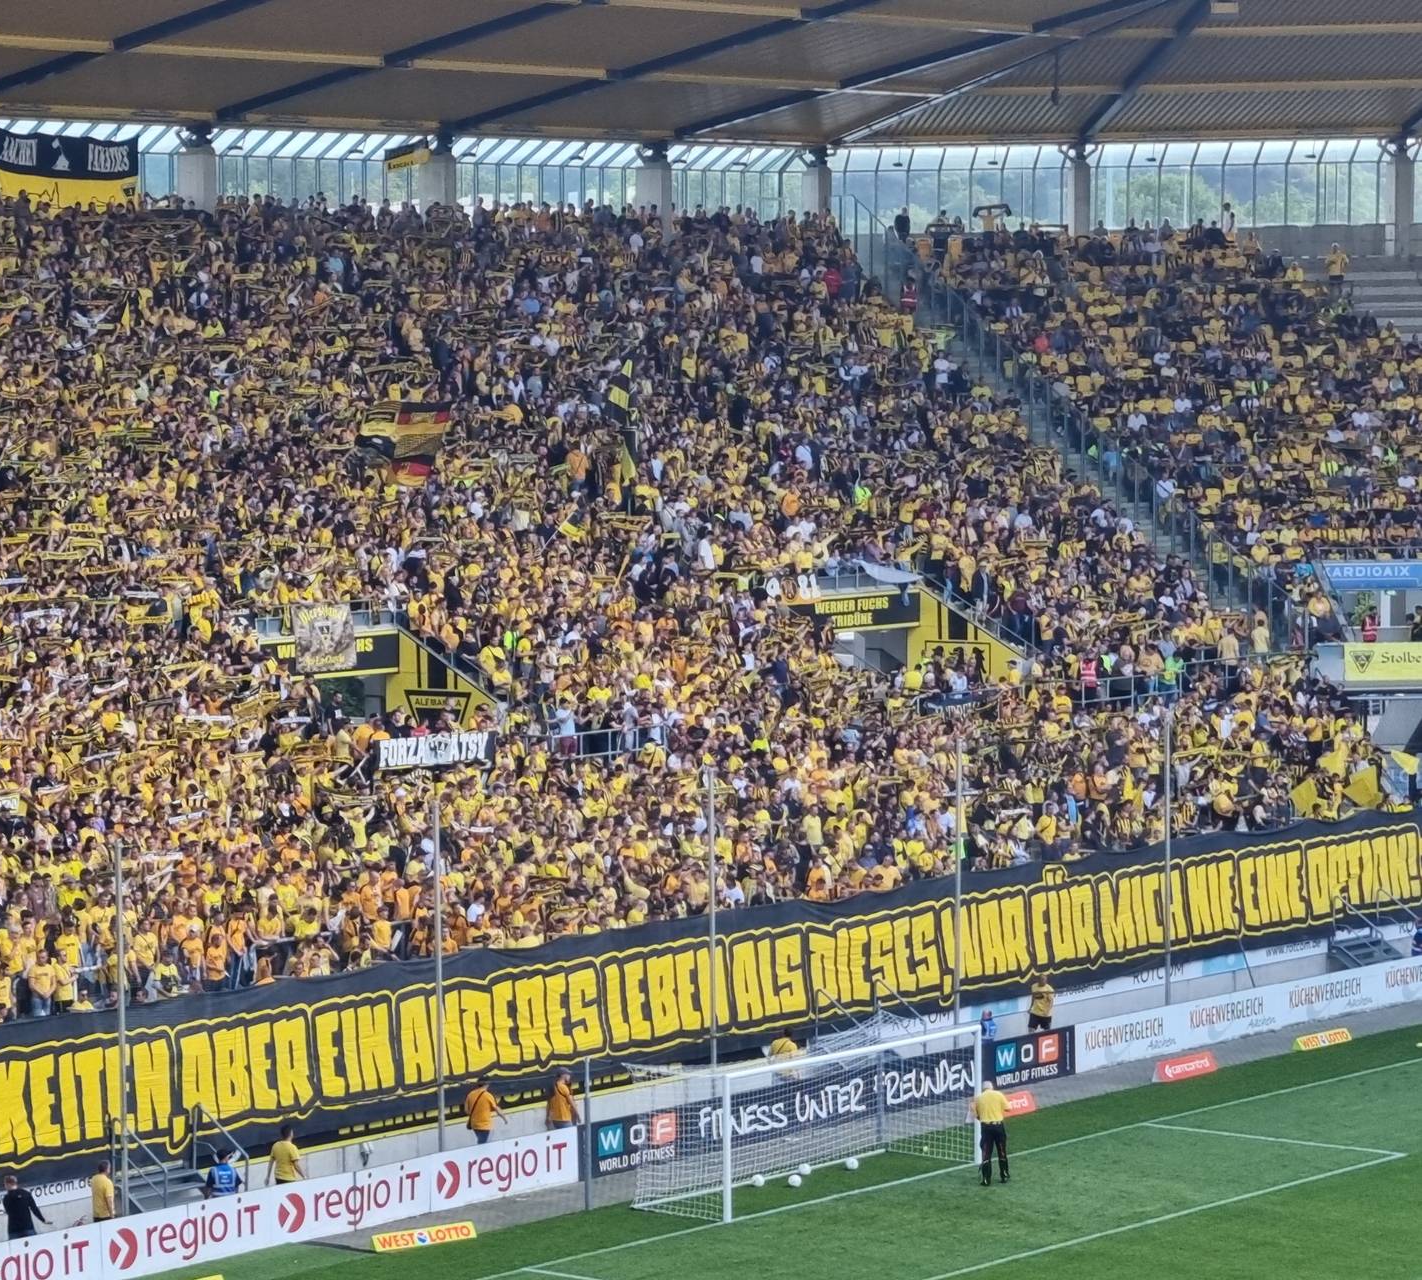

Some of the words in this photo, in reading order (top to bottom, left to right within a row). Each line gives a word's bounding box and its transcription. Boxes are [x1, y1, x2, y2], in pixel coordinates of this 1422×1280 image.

[0, 136, 37, 166] AACHEN
[814, 599, 856, 614] WERNER
[857, 596, 889, 611] FUCHS
[832, 612, 873, 627] TRIBÜNE
[379, 736, 426, 768] FORZA
[180, 1015, 315, 1121] ABER
[315, 1006, 395, 1092] EIN
[398, 966, 603, 1084] ANDERES
[601, 946, 730, 1054] LEBEN
[729, 934, 808, 1023] ALS
[1030, 866, 1098, 966] FÜR
[1097, 867, 1182, 956] MICH
[1186, 852, 1238, 940] NIE
[1239, 842, 1308, 930] EINE
[1289, 976, 1362, 1009] KÜCHENVERGLEICH
[1189, 996, 1264, 1029] KÜCHENVERGLEICH
[1085, 1016, 1164, 1051] KÜCHENVERGLEICH
[1302, 1036, 1320, 1049] WEST
[1327, 1030, 1349, 1044] LOTTO
[996, 1072, 1020, 1087] WORLD
[1021, 1070, 1030, 1082] OF
[1031, 1064, 1058, 1079] FITNESS
[698, 1102, 788, 1140] FITNESS
[795, 1077, 867, 1121] UNTER
[467, 1141, 539, 1190] regio
[599, 1155, 629, 1172] WORLD
[630, 1151, 641, 1165] OF
[642, 1145, 675, 1162] FITNESS
[314, 1172, 391, 1226] regio
[144, 1204, 228, 1260] regio
[378, 1232, 416, 1249] WEST
[429, 1225, 471, 1243] LOTTO
